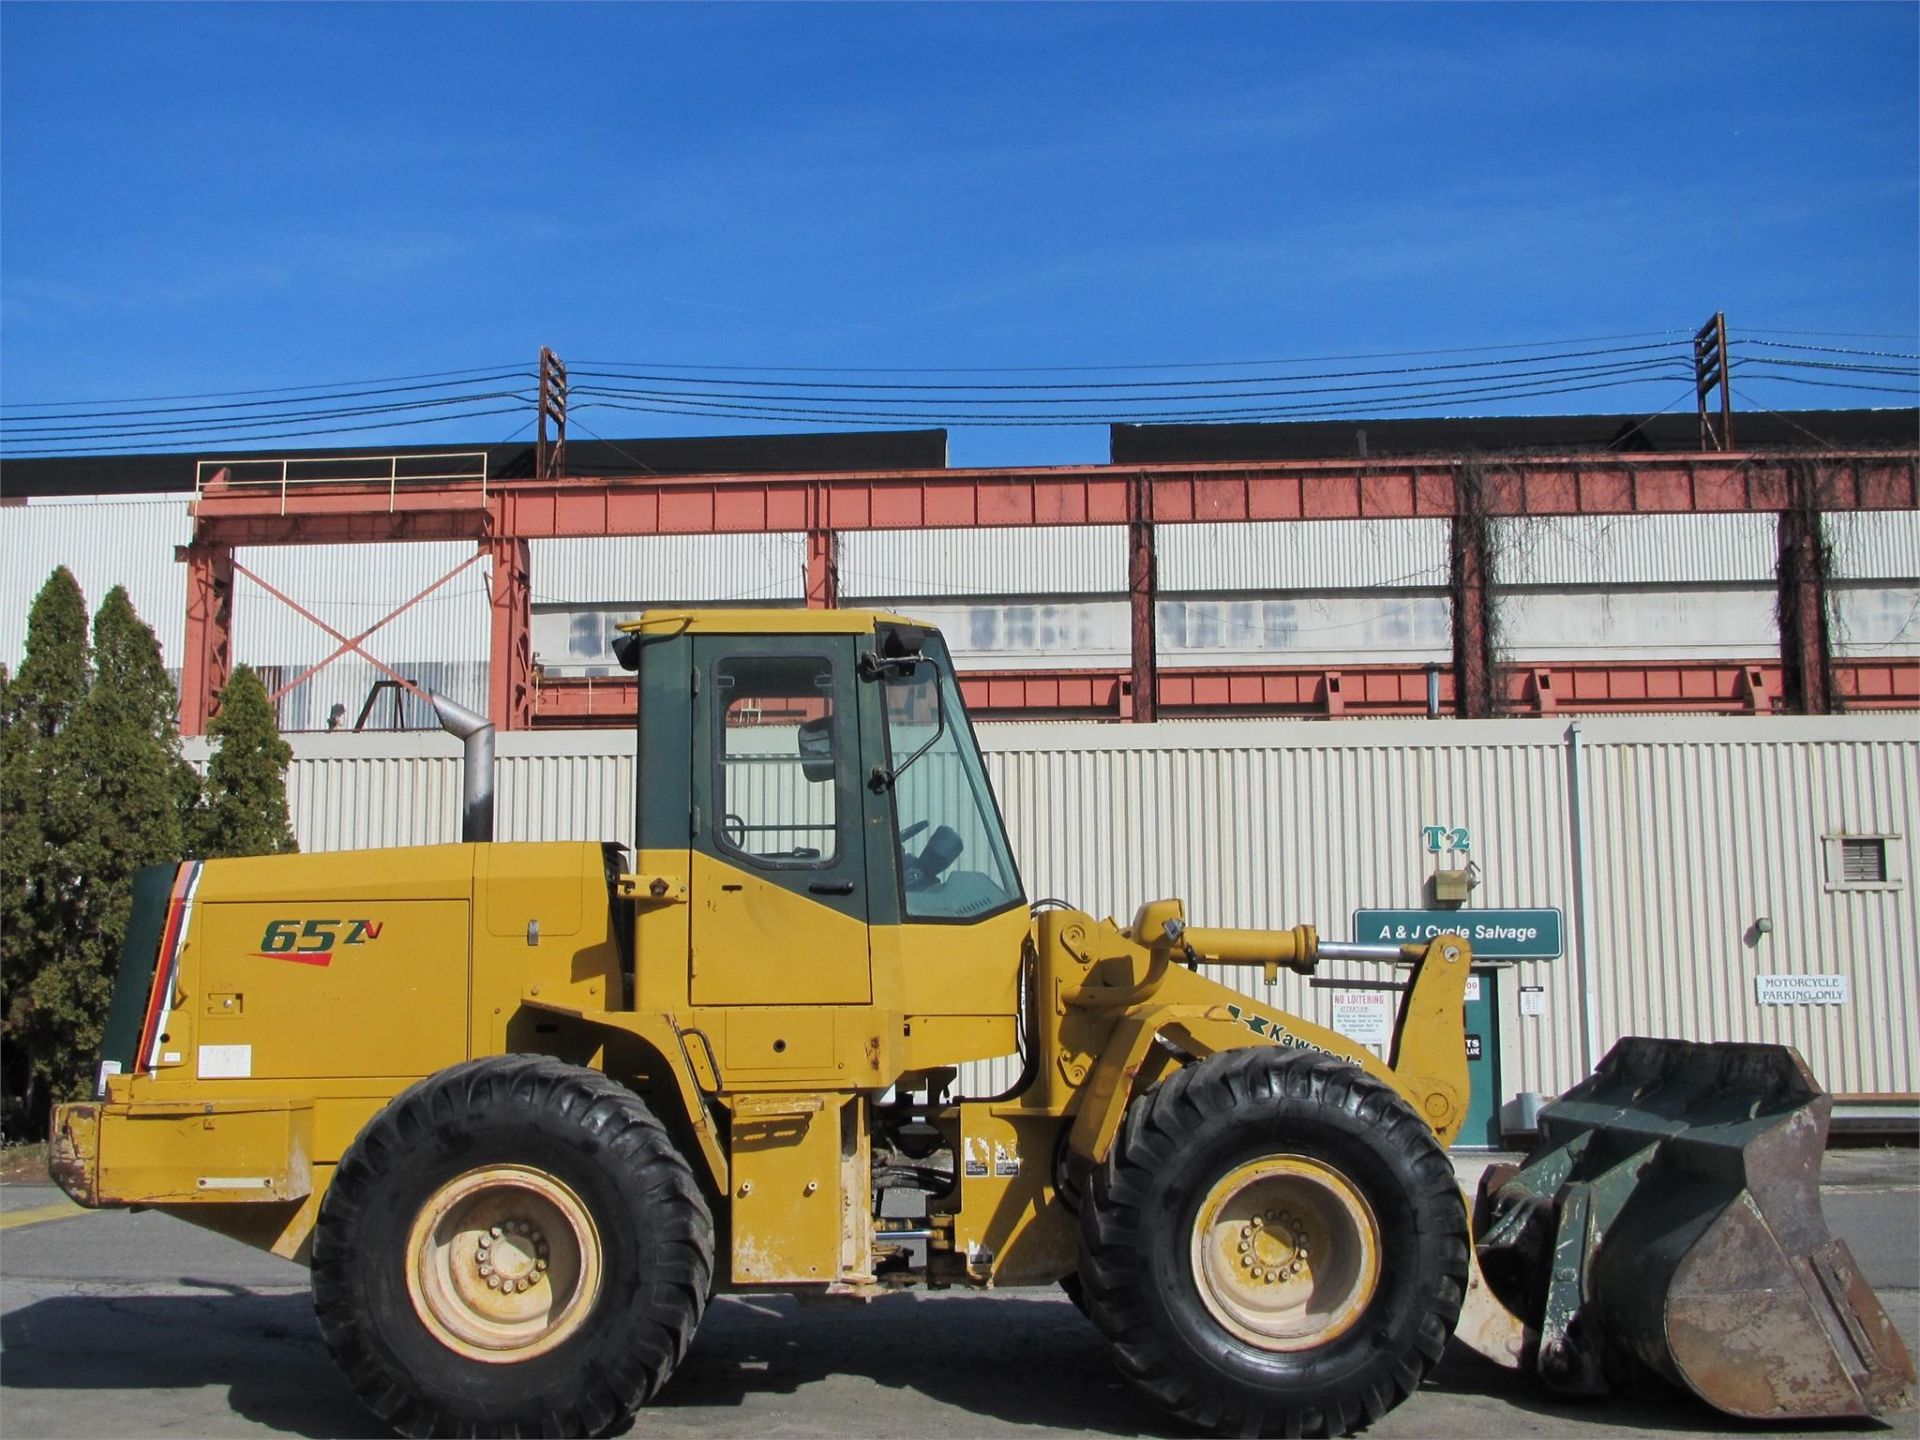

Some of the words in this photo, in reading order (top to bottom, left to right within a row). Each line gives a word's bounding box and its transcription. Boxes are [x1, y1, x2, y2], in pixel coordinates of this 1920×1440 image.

[1379, 925, 1391, 939] A
[1395, 925, 1406, 939] &
[1411, 925, 1420, 939] J
[1475, 925, 1537, 942] Salvage
[1765, 978, 1840, 988] MOTORCYCLE
[1335, 994, 1345, 1004] NO
[1347, 994, 1385, 1005] LOITERING
[1762, 990, 1812, 1000] PARKING
[1815, 990, 1844, 1000] ONLY
[1268, 1023, 1362, 1066] Kawa
